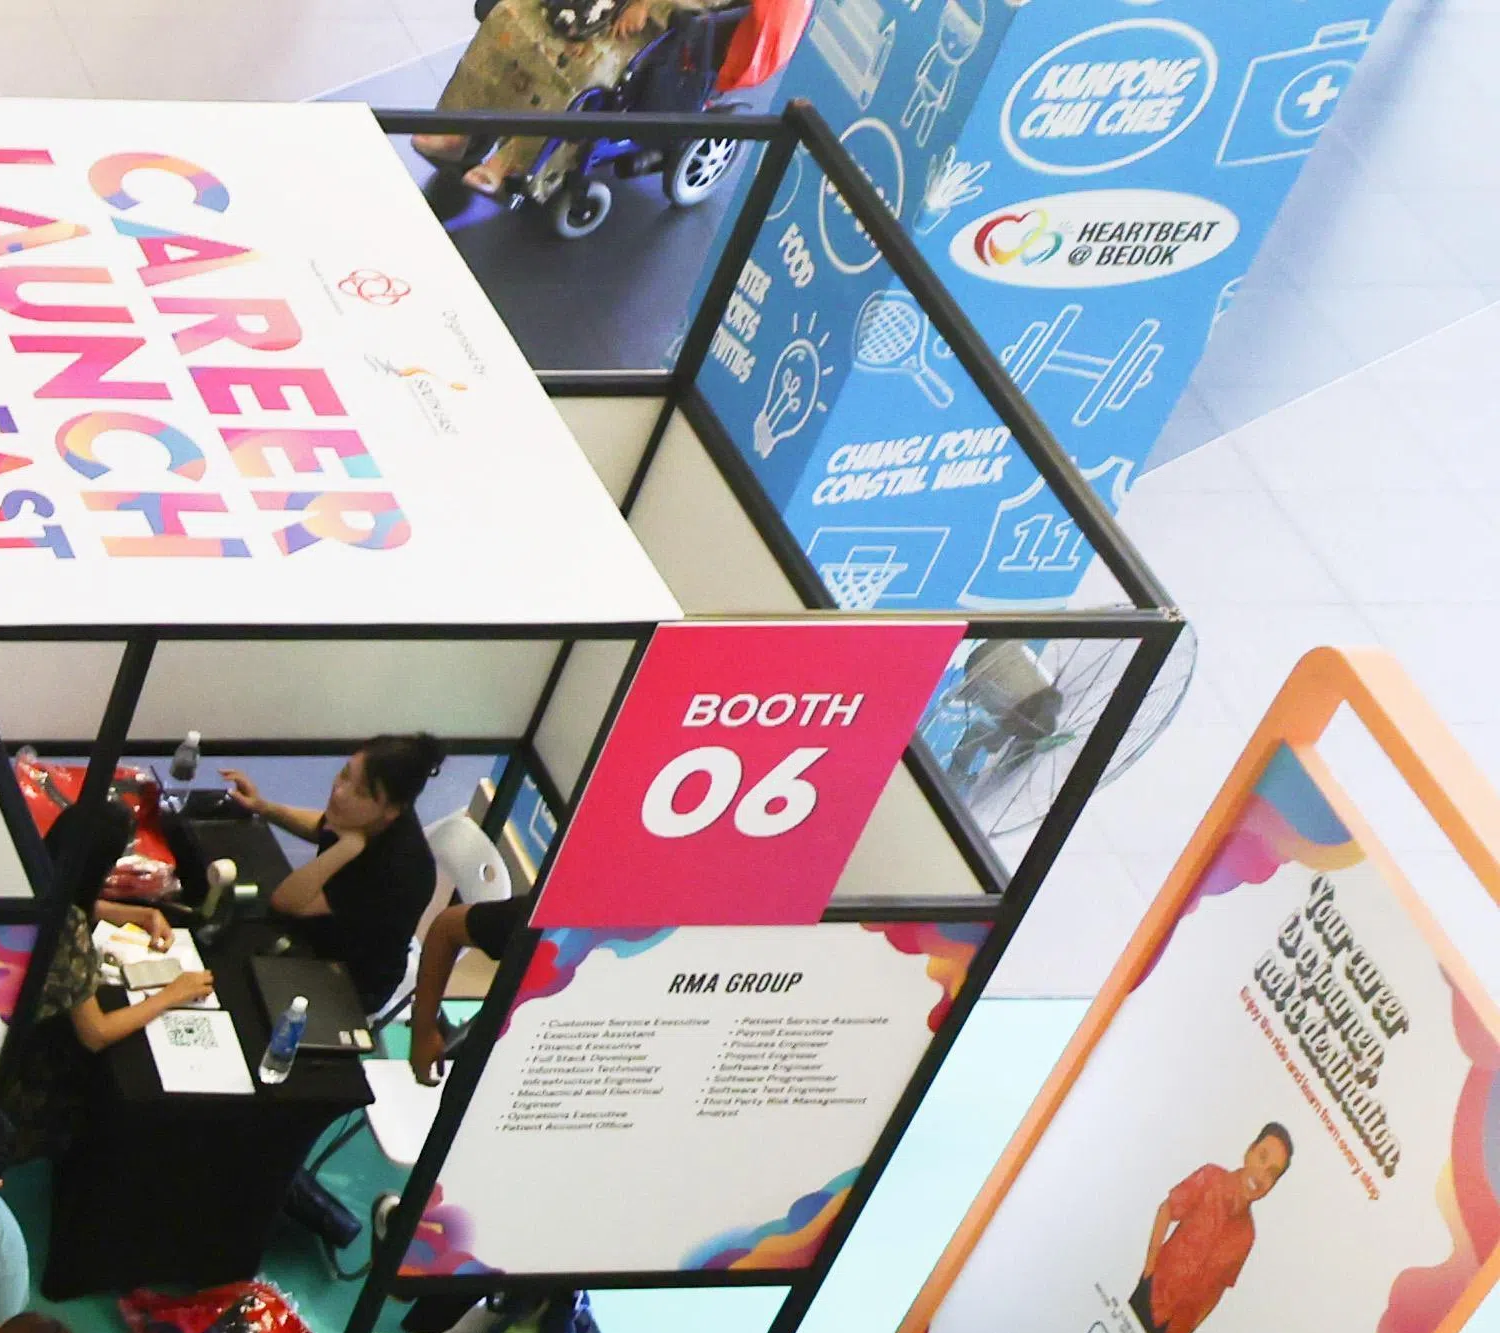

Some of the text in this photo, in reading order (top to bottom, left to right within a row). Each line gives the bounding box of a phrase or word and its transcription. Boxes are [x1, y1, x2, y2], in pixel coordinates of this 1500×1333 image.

[1032, 58, 1201, 100] KAMPONG
[1019, 96, 1185, 139] CHAI CHEE
[778, 222, 814, 288] FOOD
[1068, 245, 1180, 267] @ BEDOK
[1076, 221, 1219, 243] HEARTBEAT
[87, 152, 412, 555] CAREER
[827, 425, 1012, 474] CHANGI POINT
[812, 455, 1012, 506] COASTAL WALK
[681, 693, 865, 728] BOOTH
[641, 746, 828, 839] 06
[1278, 906, 1305, 958] is
[1296, 941, 1318, 975] a
[1306, 871, 1410, 1038] Your career
[669, 971, 803, 995] RMA GROUP
[1254, 948, 1297, 1012] not
[1284, 993, 1308, 1036] a
[1261, 1015, 1274, 1038] the
[1272, 1034, 1288, 1061] ride
[1287, 1060, 1302, 1084] and
[1300, 1082, 1322, 1116] learn
[1320, 1106, 1340, 1142] from
[1339, 1140, 1364, 1176] every
[1360, 1170, 1380, 1200] stop
